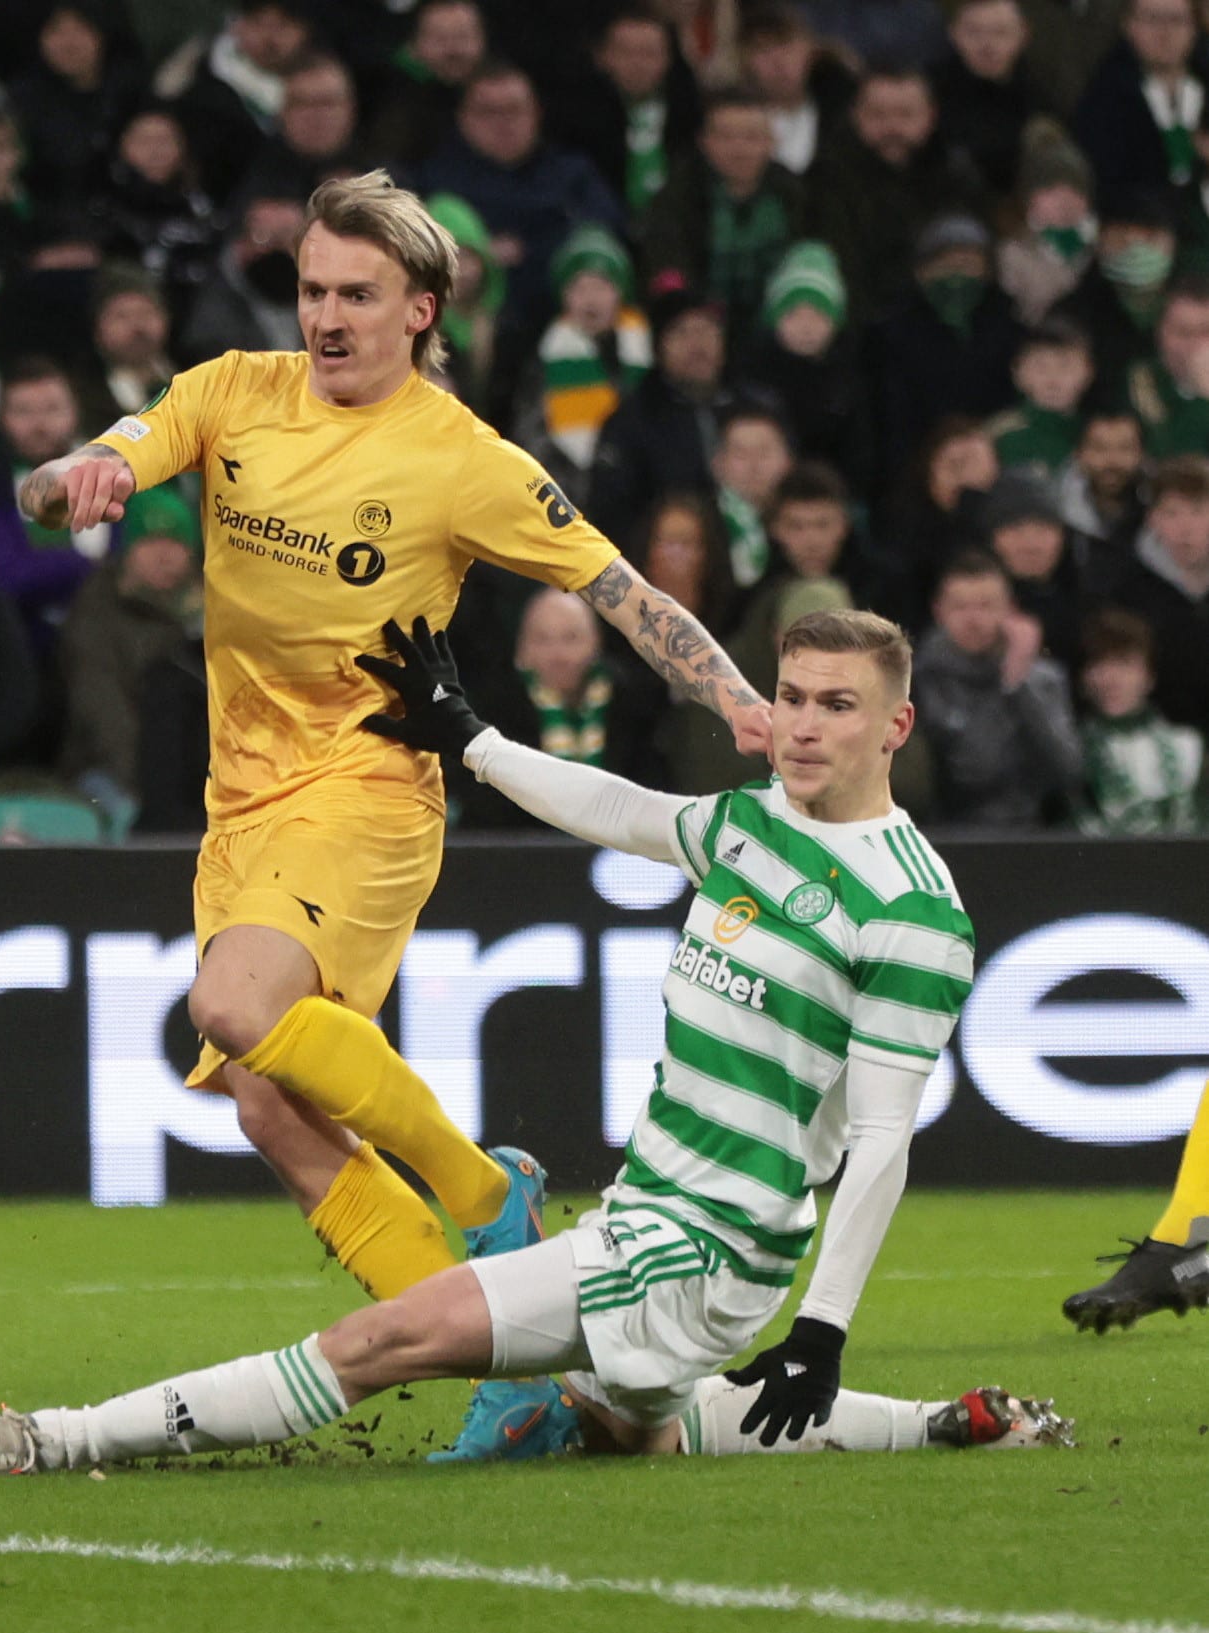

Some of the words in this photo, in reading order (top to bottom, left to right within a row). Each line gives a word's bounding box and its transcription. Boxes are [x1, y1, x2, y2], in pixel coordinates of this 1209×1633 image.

[214, 493, 336, 559] SpareBank
[228, 534, 329, 576] NORD-NORGE
[671, 933, 767, 1011] dafabet
